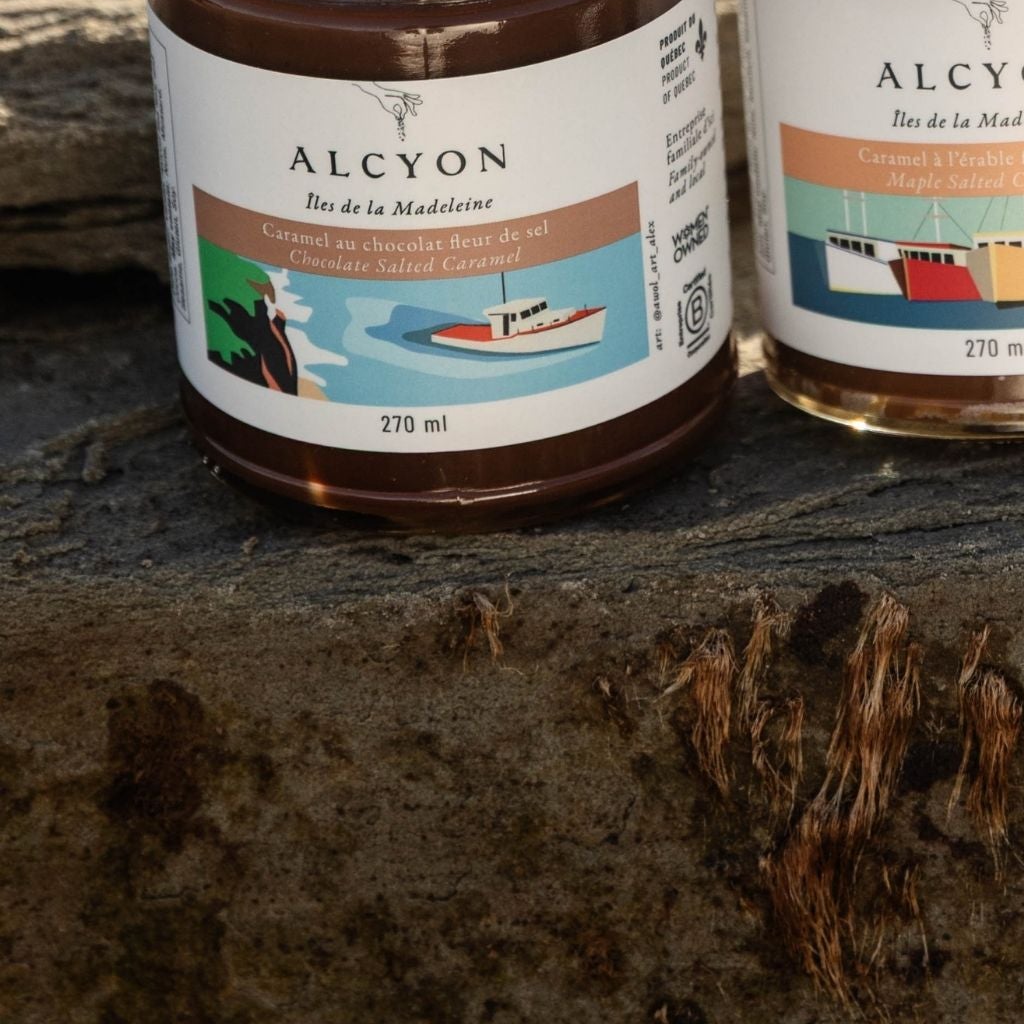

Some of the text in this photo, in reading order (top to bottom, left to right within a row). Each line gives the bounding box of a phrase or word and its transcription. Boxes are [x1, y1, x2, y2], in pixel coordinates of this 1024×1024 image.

[659, 20, 687, 51] PRODUIT
[892, 109, 921, 128] Îles
[927, 112, 947, 129] de
[953, 112, 970, 129] la
[289, 143, 506, 179] ALCYON
[858, 146, 927, 168] Caramel
[933, 153, 943, 168] à
[886, 172, 942, 195] Maple
[947, 172, 1005, 190] Salted
[305, 192, 494, 216] Îles de la Madeleine
[262, 219, 549, 252] Caramel au chocolat fleur de sel
[289, 246, 521, 273] Chocolate Salted Caramel
[965, 338, 999, 358] 270
[381, 414, 447, 433] 270 ml
